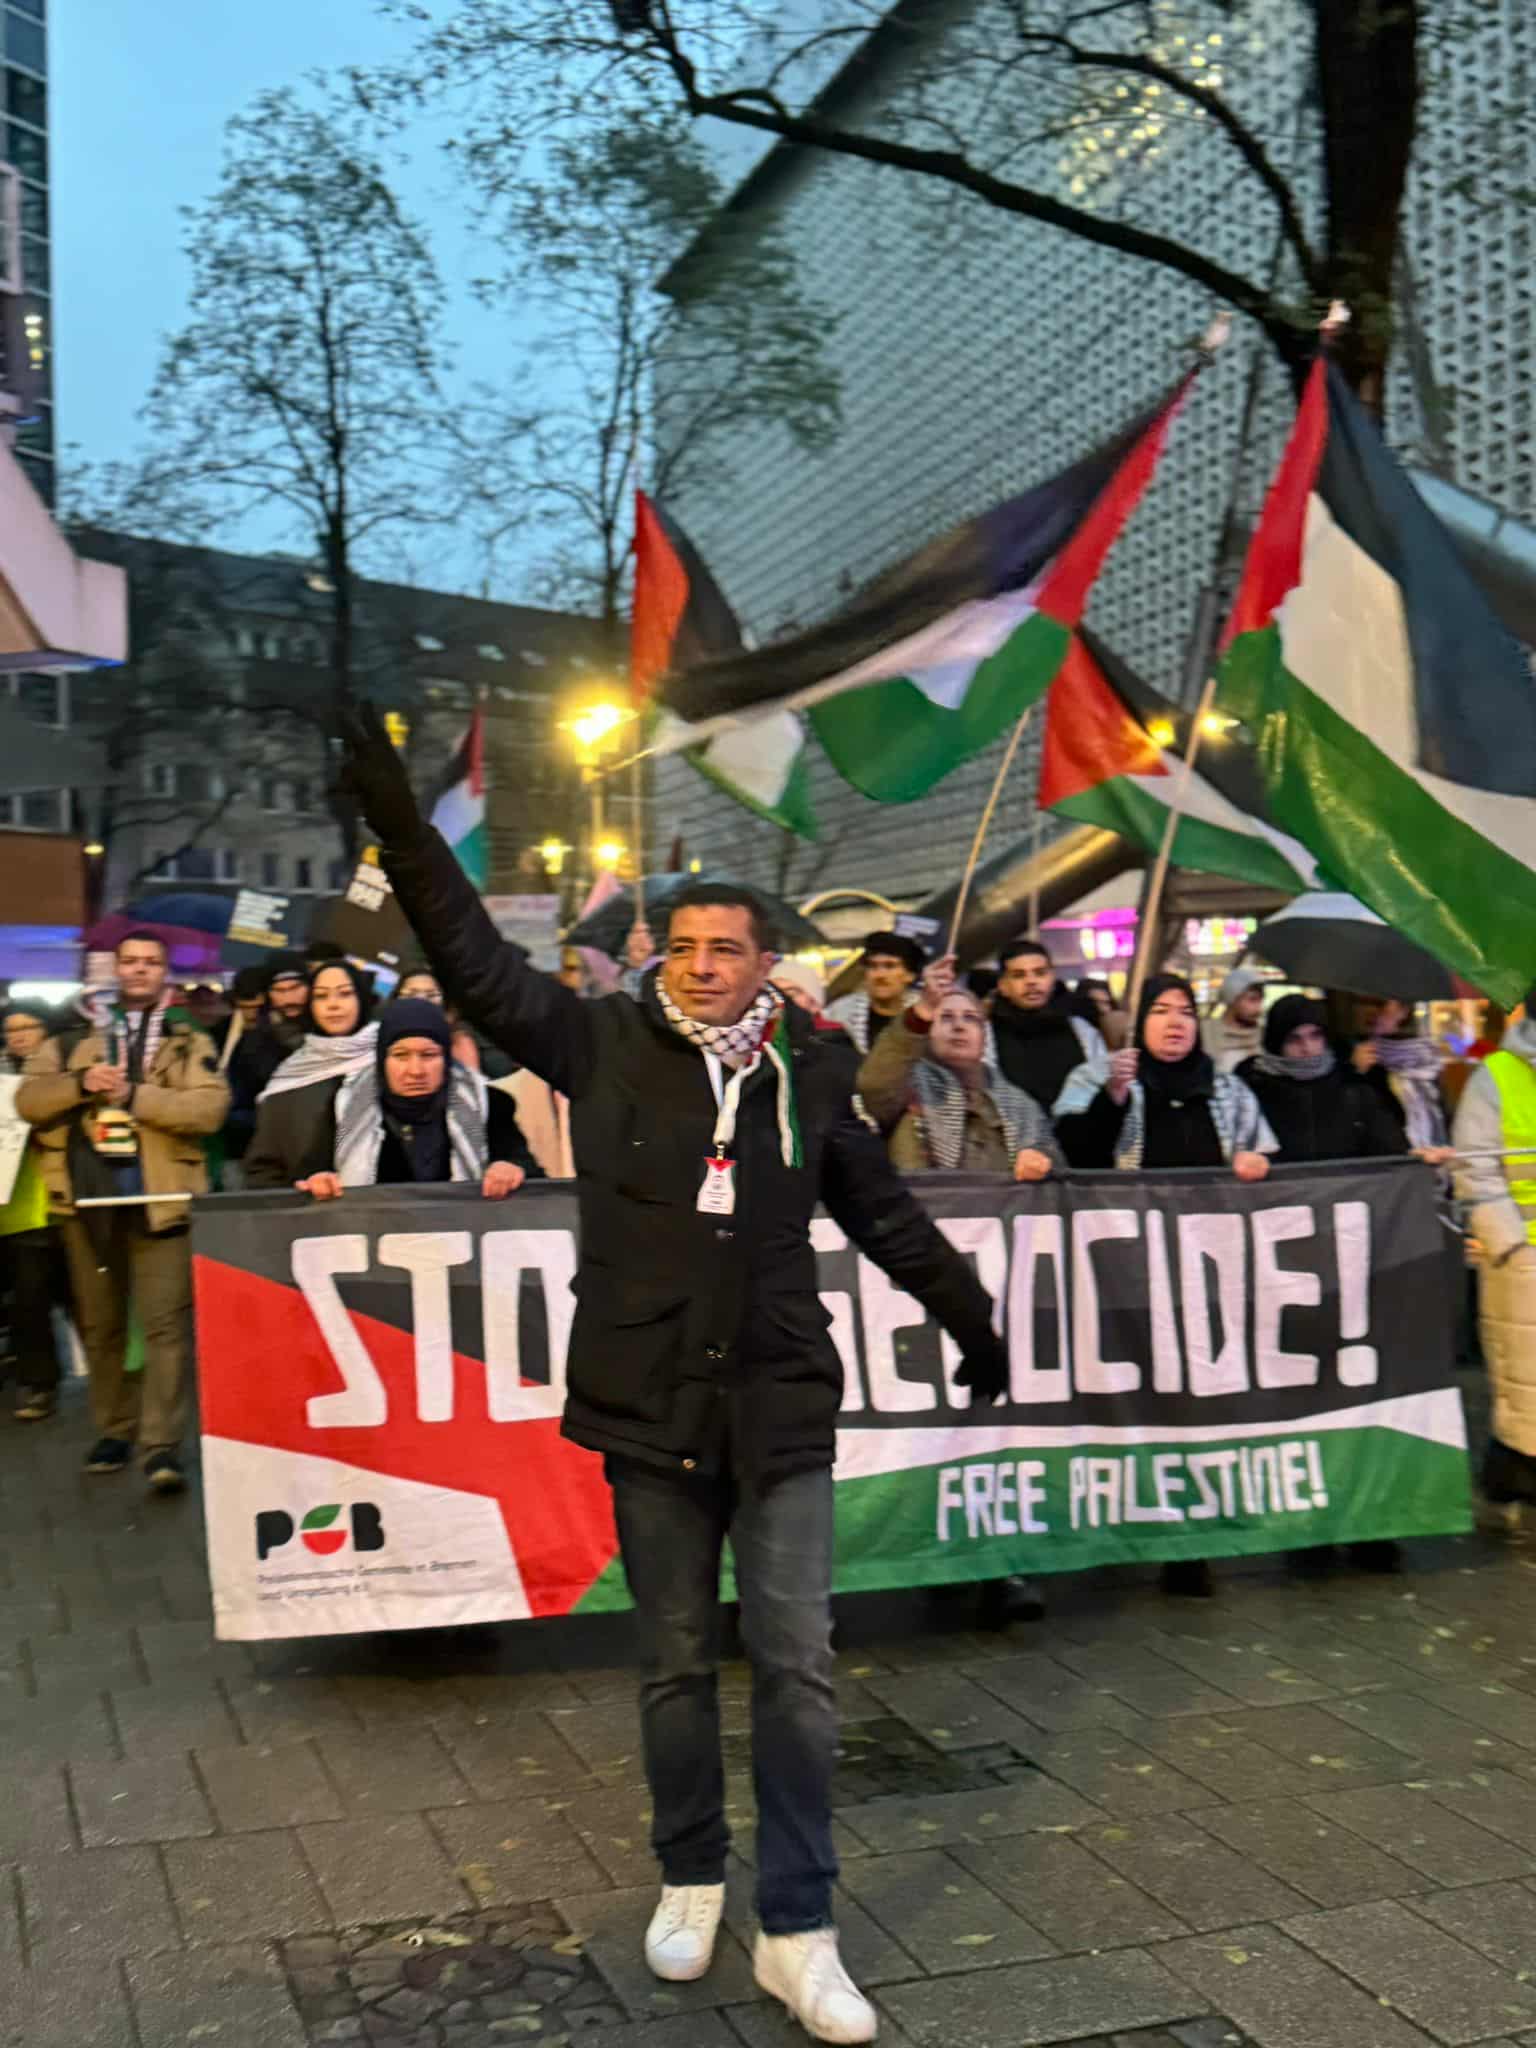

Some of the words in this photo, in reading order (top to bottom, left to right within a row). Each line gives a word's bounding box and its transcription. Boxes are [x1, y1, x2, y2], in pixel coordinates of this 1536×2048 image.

[291, 1229, 578, 1429] STO
[937, 1460, 1049, 1542] FREE
[1069, 1440, 1330, 1531] PALESTINE!
